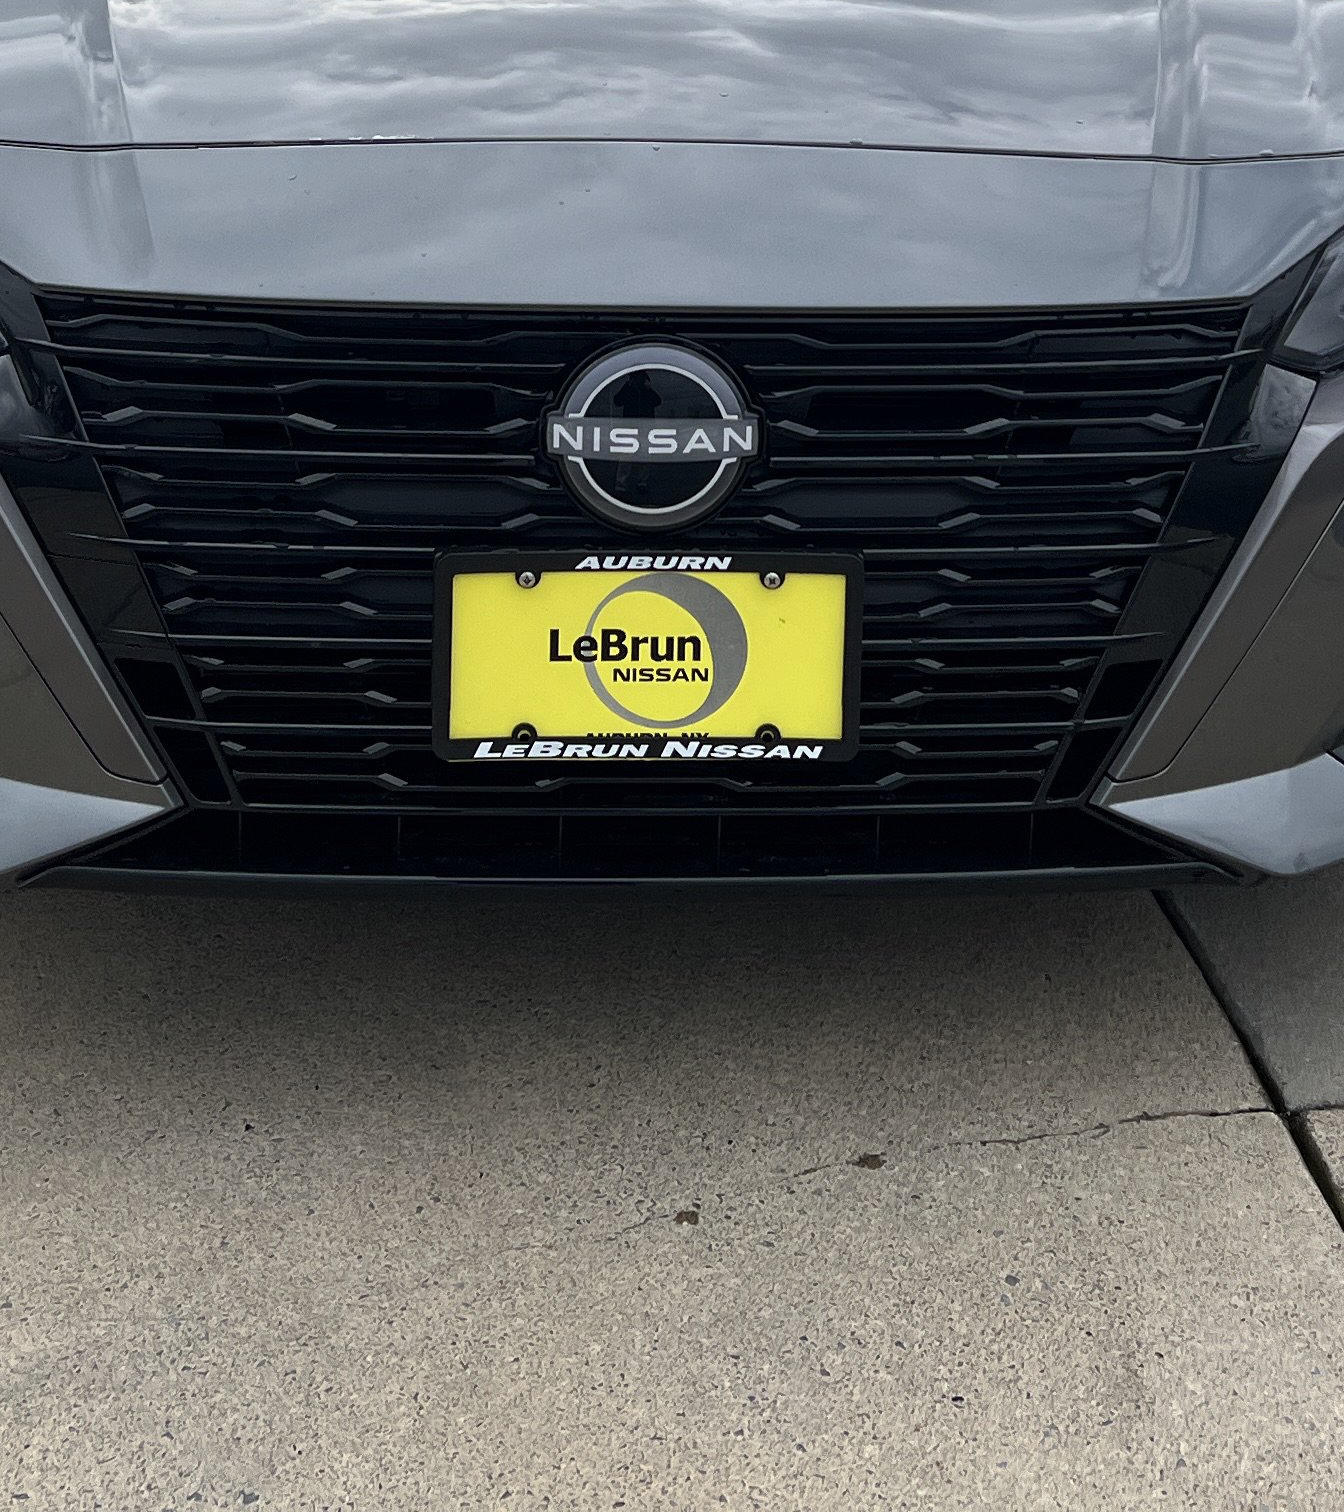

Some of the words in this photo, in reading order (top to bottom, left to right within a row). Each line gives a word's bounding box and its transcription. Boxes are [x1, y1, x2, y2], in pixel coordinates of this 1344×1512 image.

[552, 423, 753, 455] NISSAN
[574, 555, 732, 571] AUBURN
[549, 628, 702, 663] LeBrun
[612, 667, 710, 683] NISSAN
